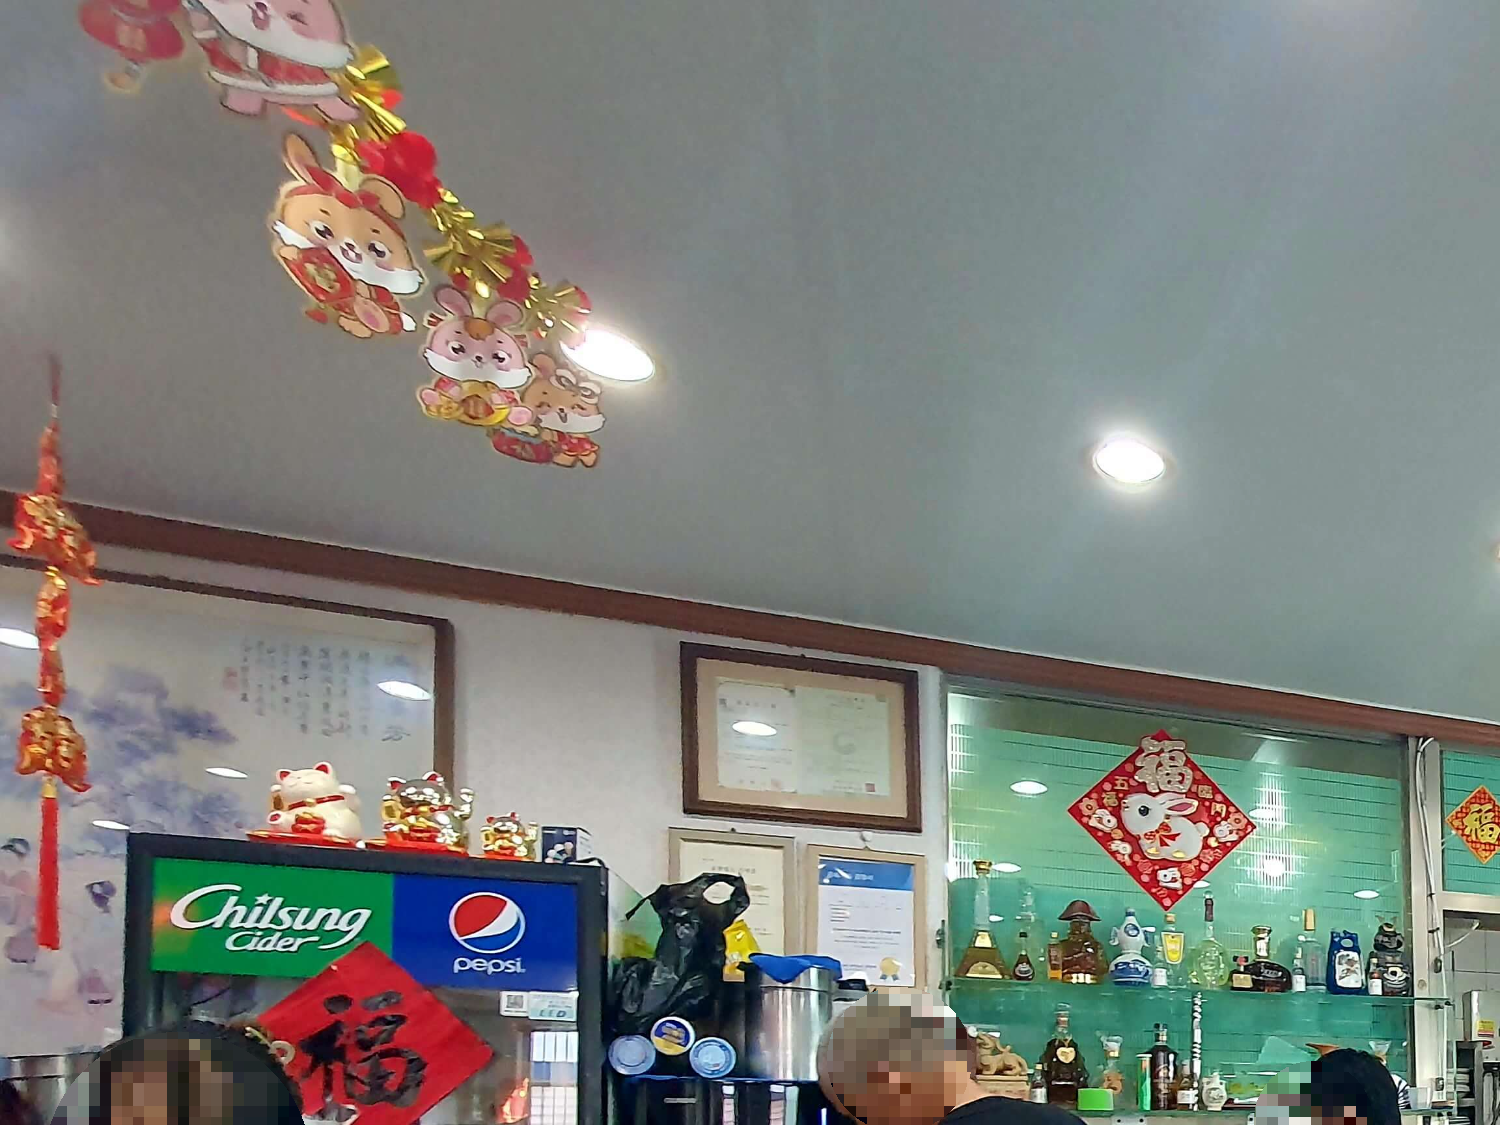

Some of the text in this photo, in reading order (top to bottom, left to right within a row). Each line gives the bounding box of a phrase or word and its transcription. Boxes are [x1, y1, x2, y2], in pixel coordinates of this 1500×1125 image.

[170, 884, 372, 949] Chilsung
[225, 931, 319, 953] Cider
[453, 956, 525, 976] pepsi
[300, 990, 430, 1108] 福
